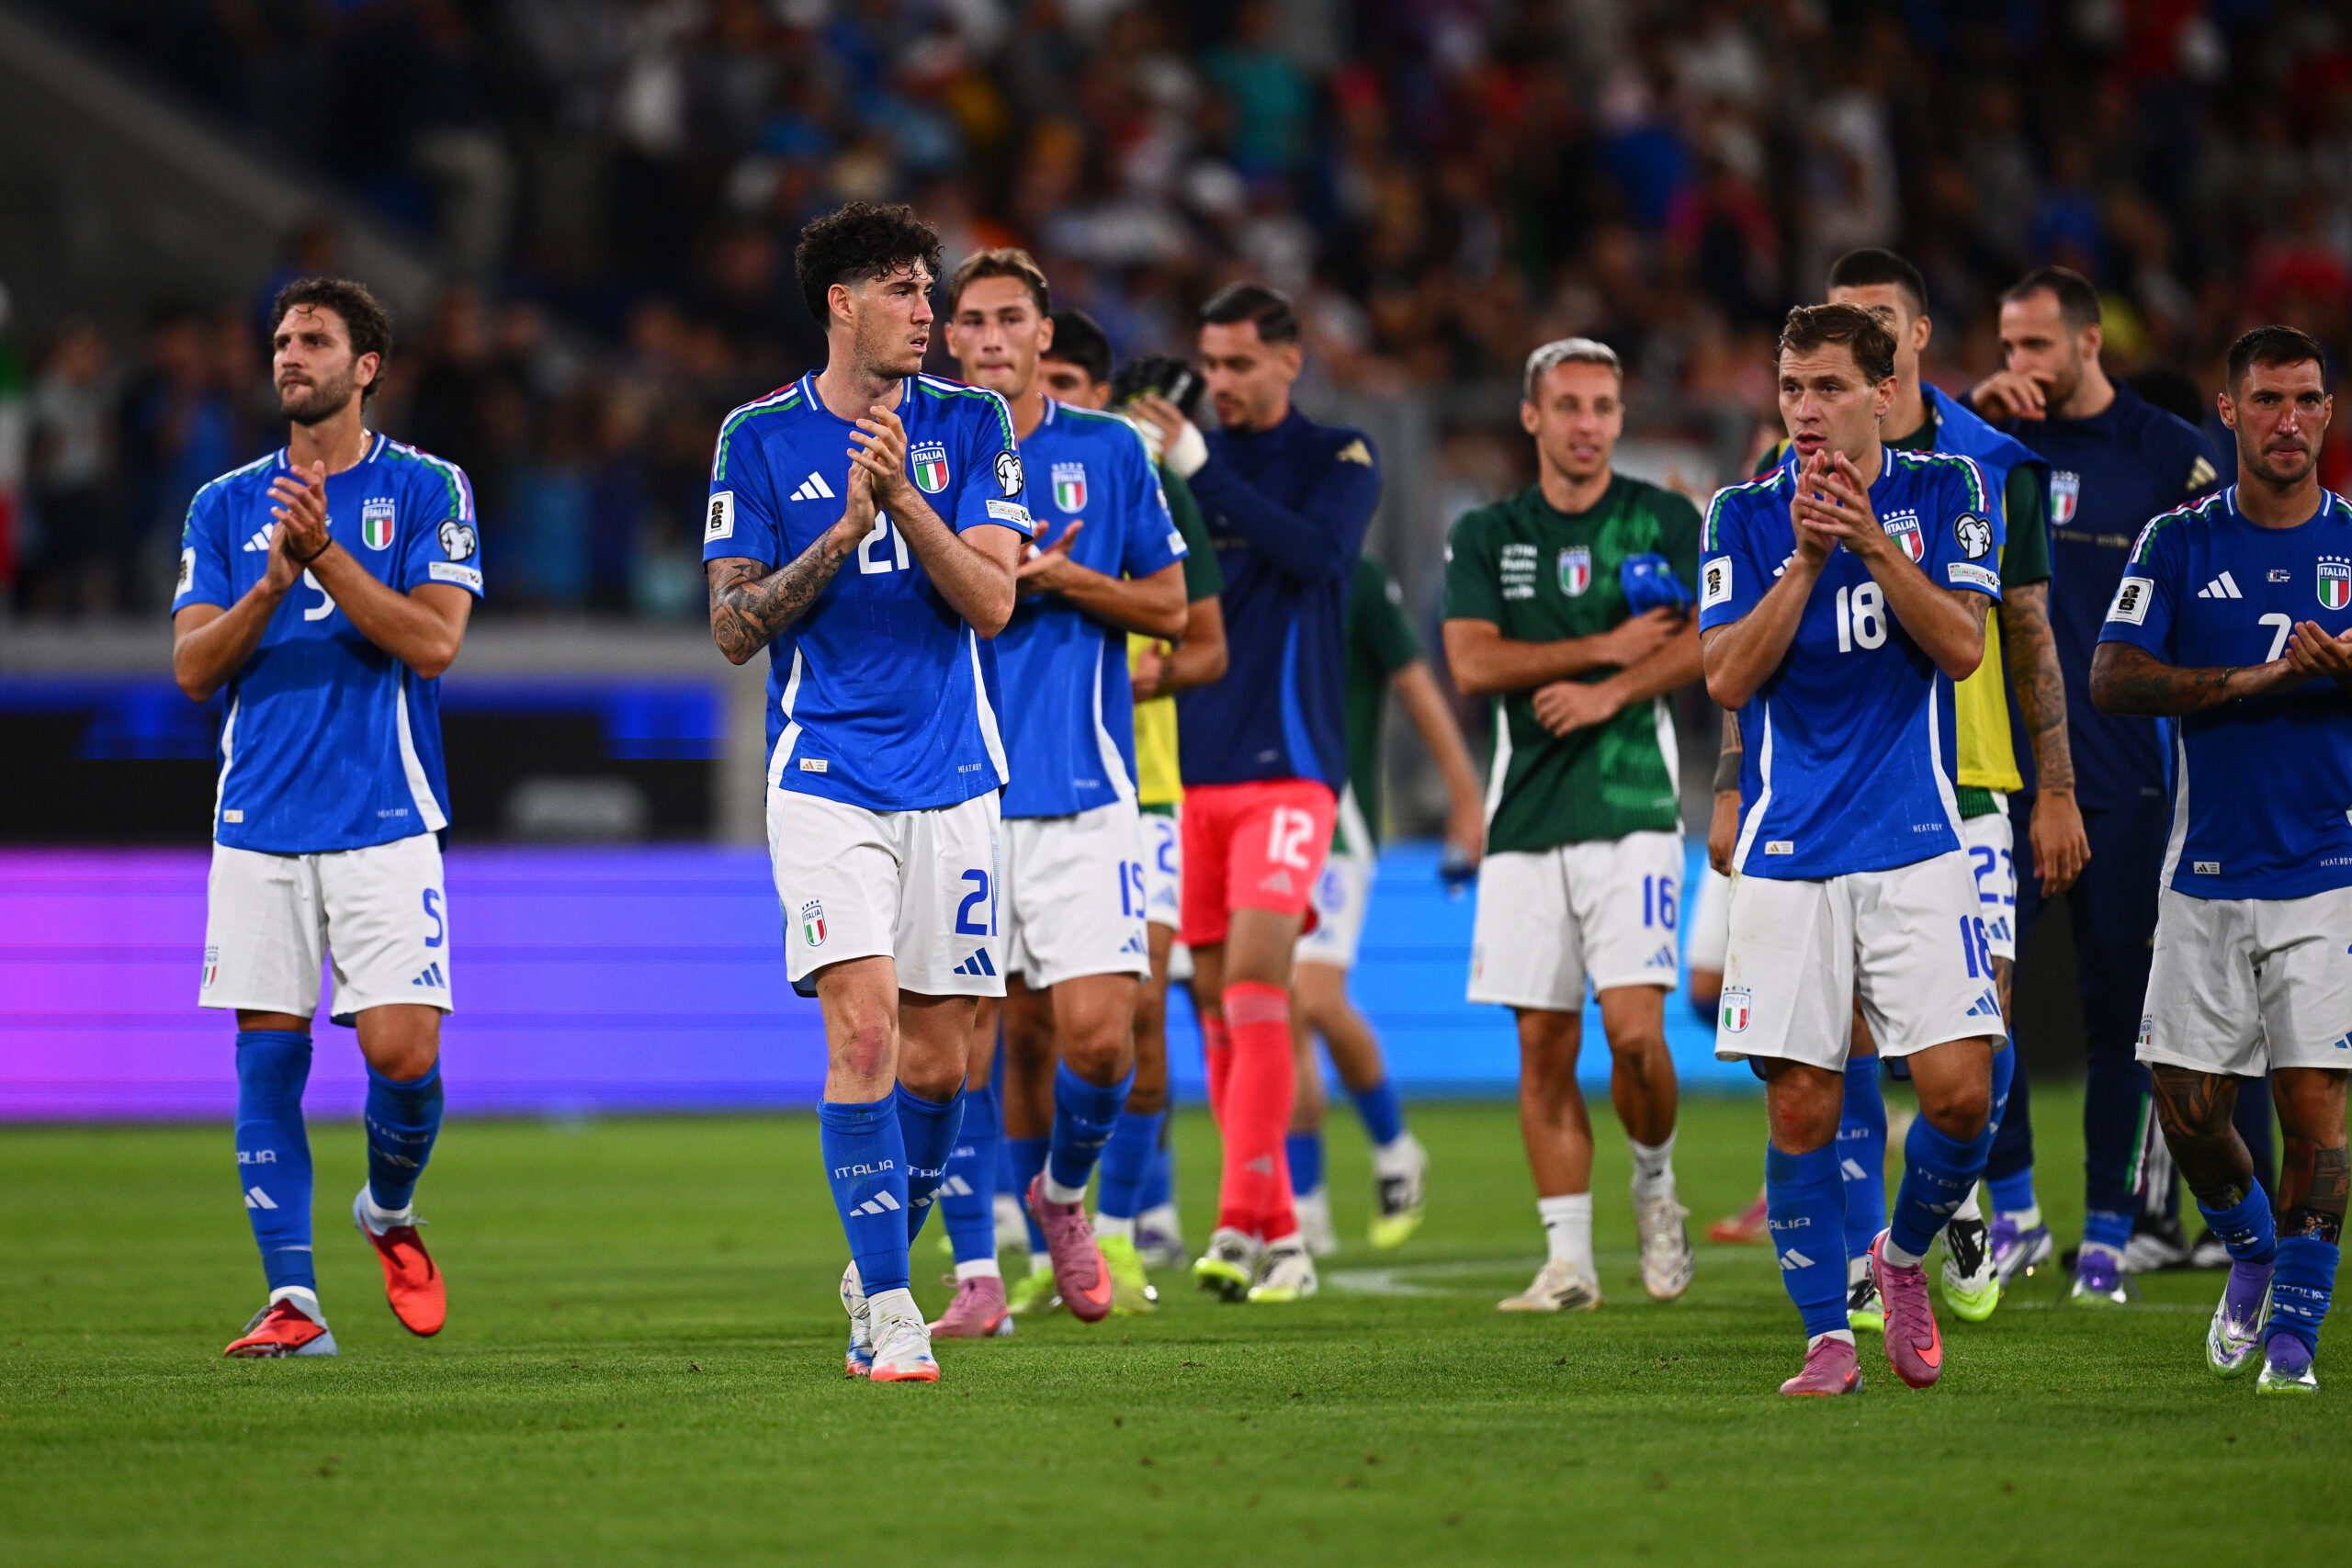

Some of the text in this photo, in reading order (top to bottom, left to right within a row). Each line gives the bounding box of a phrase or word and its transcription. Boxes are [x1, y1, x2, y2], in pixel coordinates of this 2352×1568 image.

[914, 450, 944, 462] ITALIA
[857, 510, 910, 575] 21
[1887, 520, 1917, 534] ITALIA
[2320, 567, 2348, 577] ITALIA
[1836, 581, 1888, 653] 18
[2258, 613, 2292, 663] 7
[1267, 807, 1314, 870] 12
[804, 908, 821, 921] ITALIA
[955, 868, 999, 937] 21
[1643, 874, 1677, 931] 16
[235, 1149, 277, 1166] ALIA
[834, 1159, 894, 1179] ITALIA
